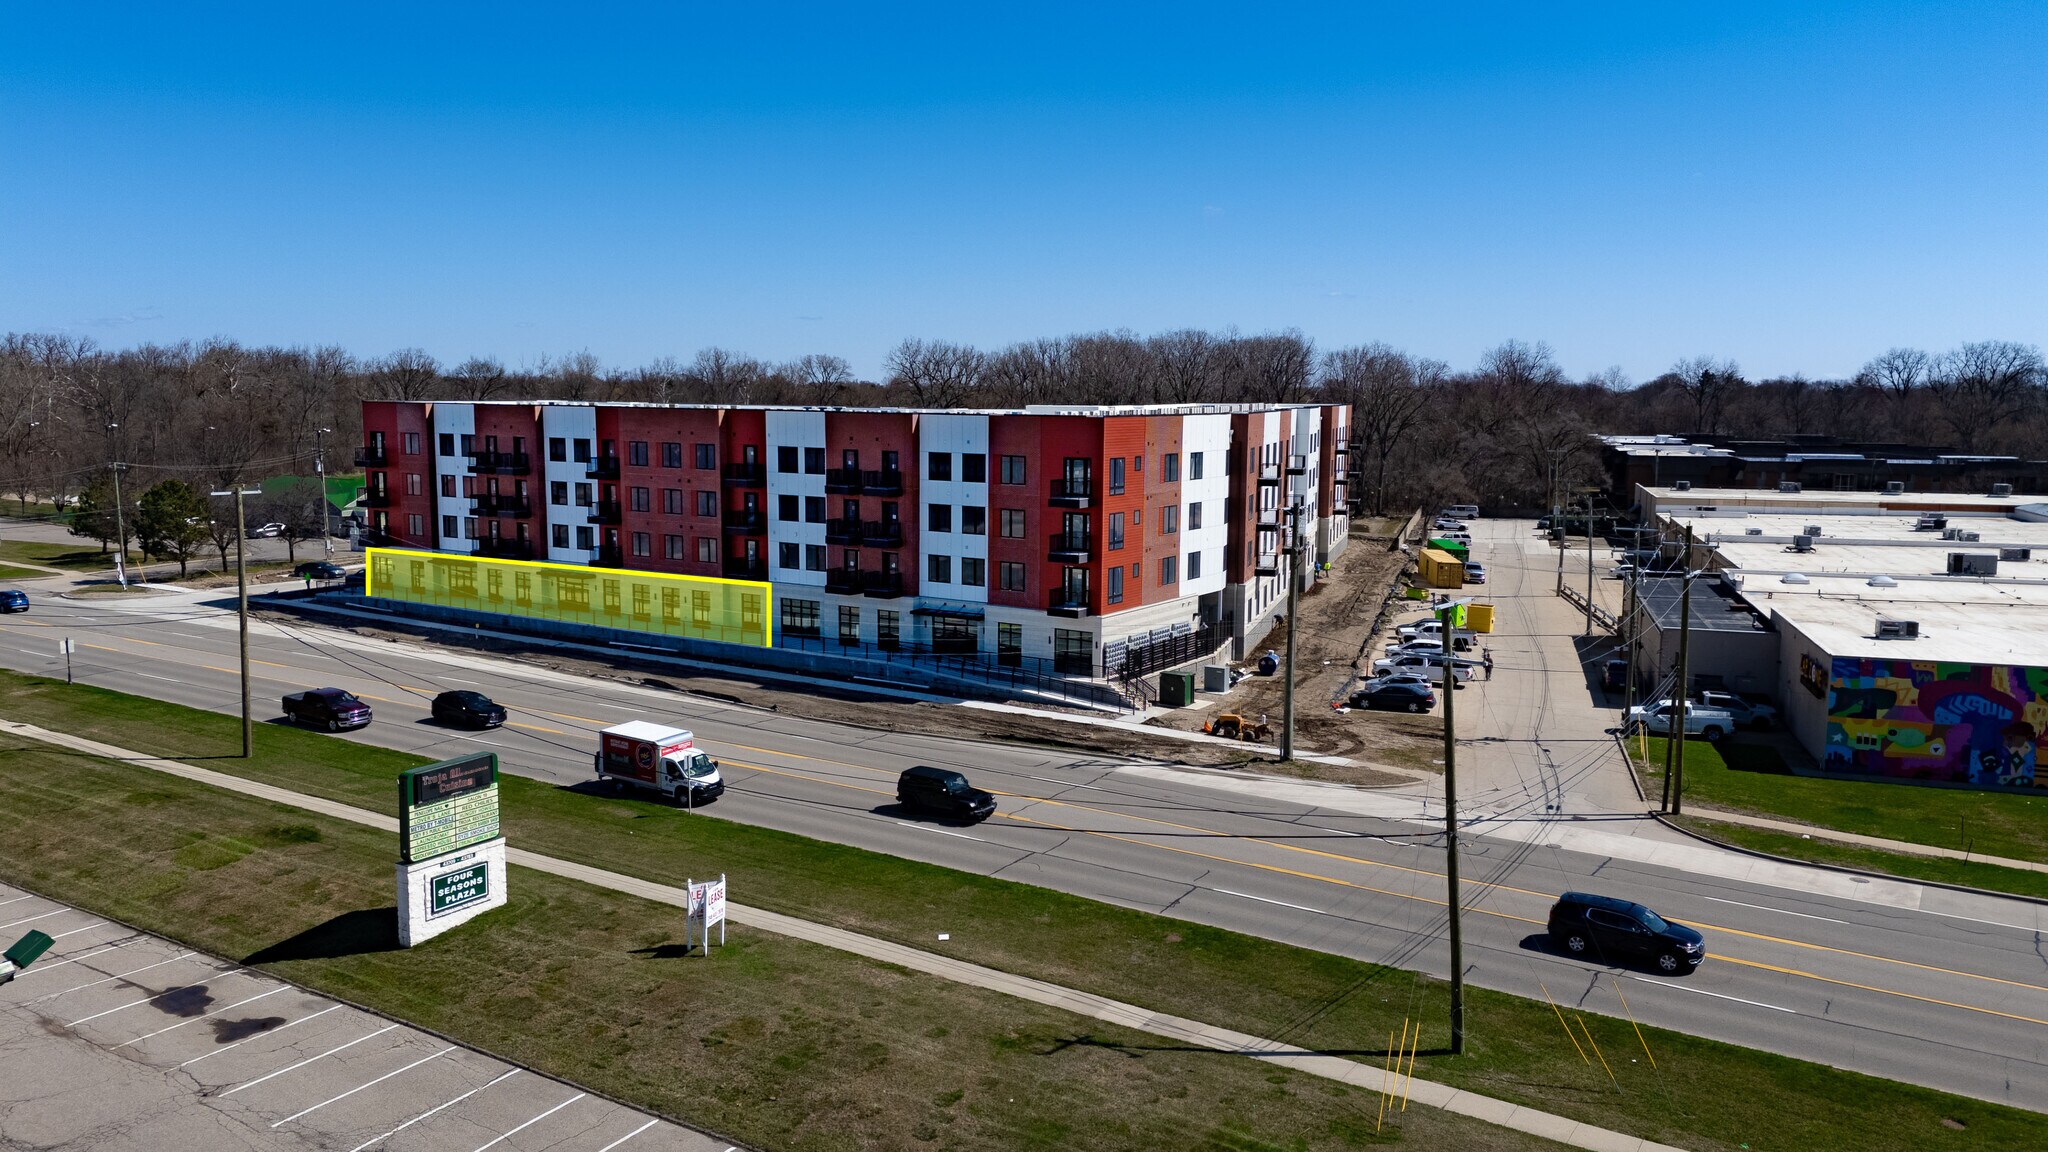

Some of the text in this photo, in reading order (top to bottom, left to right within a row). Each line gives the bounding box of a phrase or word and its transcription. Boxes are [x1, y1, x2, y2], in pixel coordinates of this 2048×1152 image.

[437, 810, 451, 818] LANE
[472, 810, 498, 822] RESTAURANT
[410, 824, 426, 833] METRO
[434, 815, 454, 825] T-MOBILE
[416, 831, 450, 845] LAUNDROMAT
[470, 828, 486, 836] SMOKE
[440, 843, 456, 851] TATTOO
[447, 871, 473, 884] FOUR
[438, 877, 483, 896] SEASONS
[446, 888, 476, 904] PLAZA
[708, 889, 723, 905] LEASE
